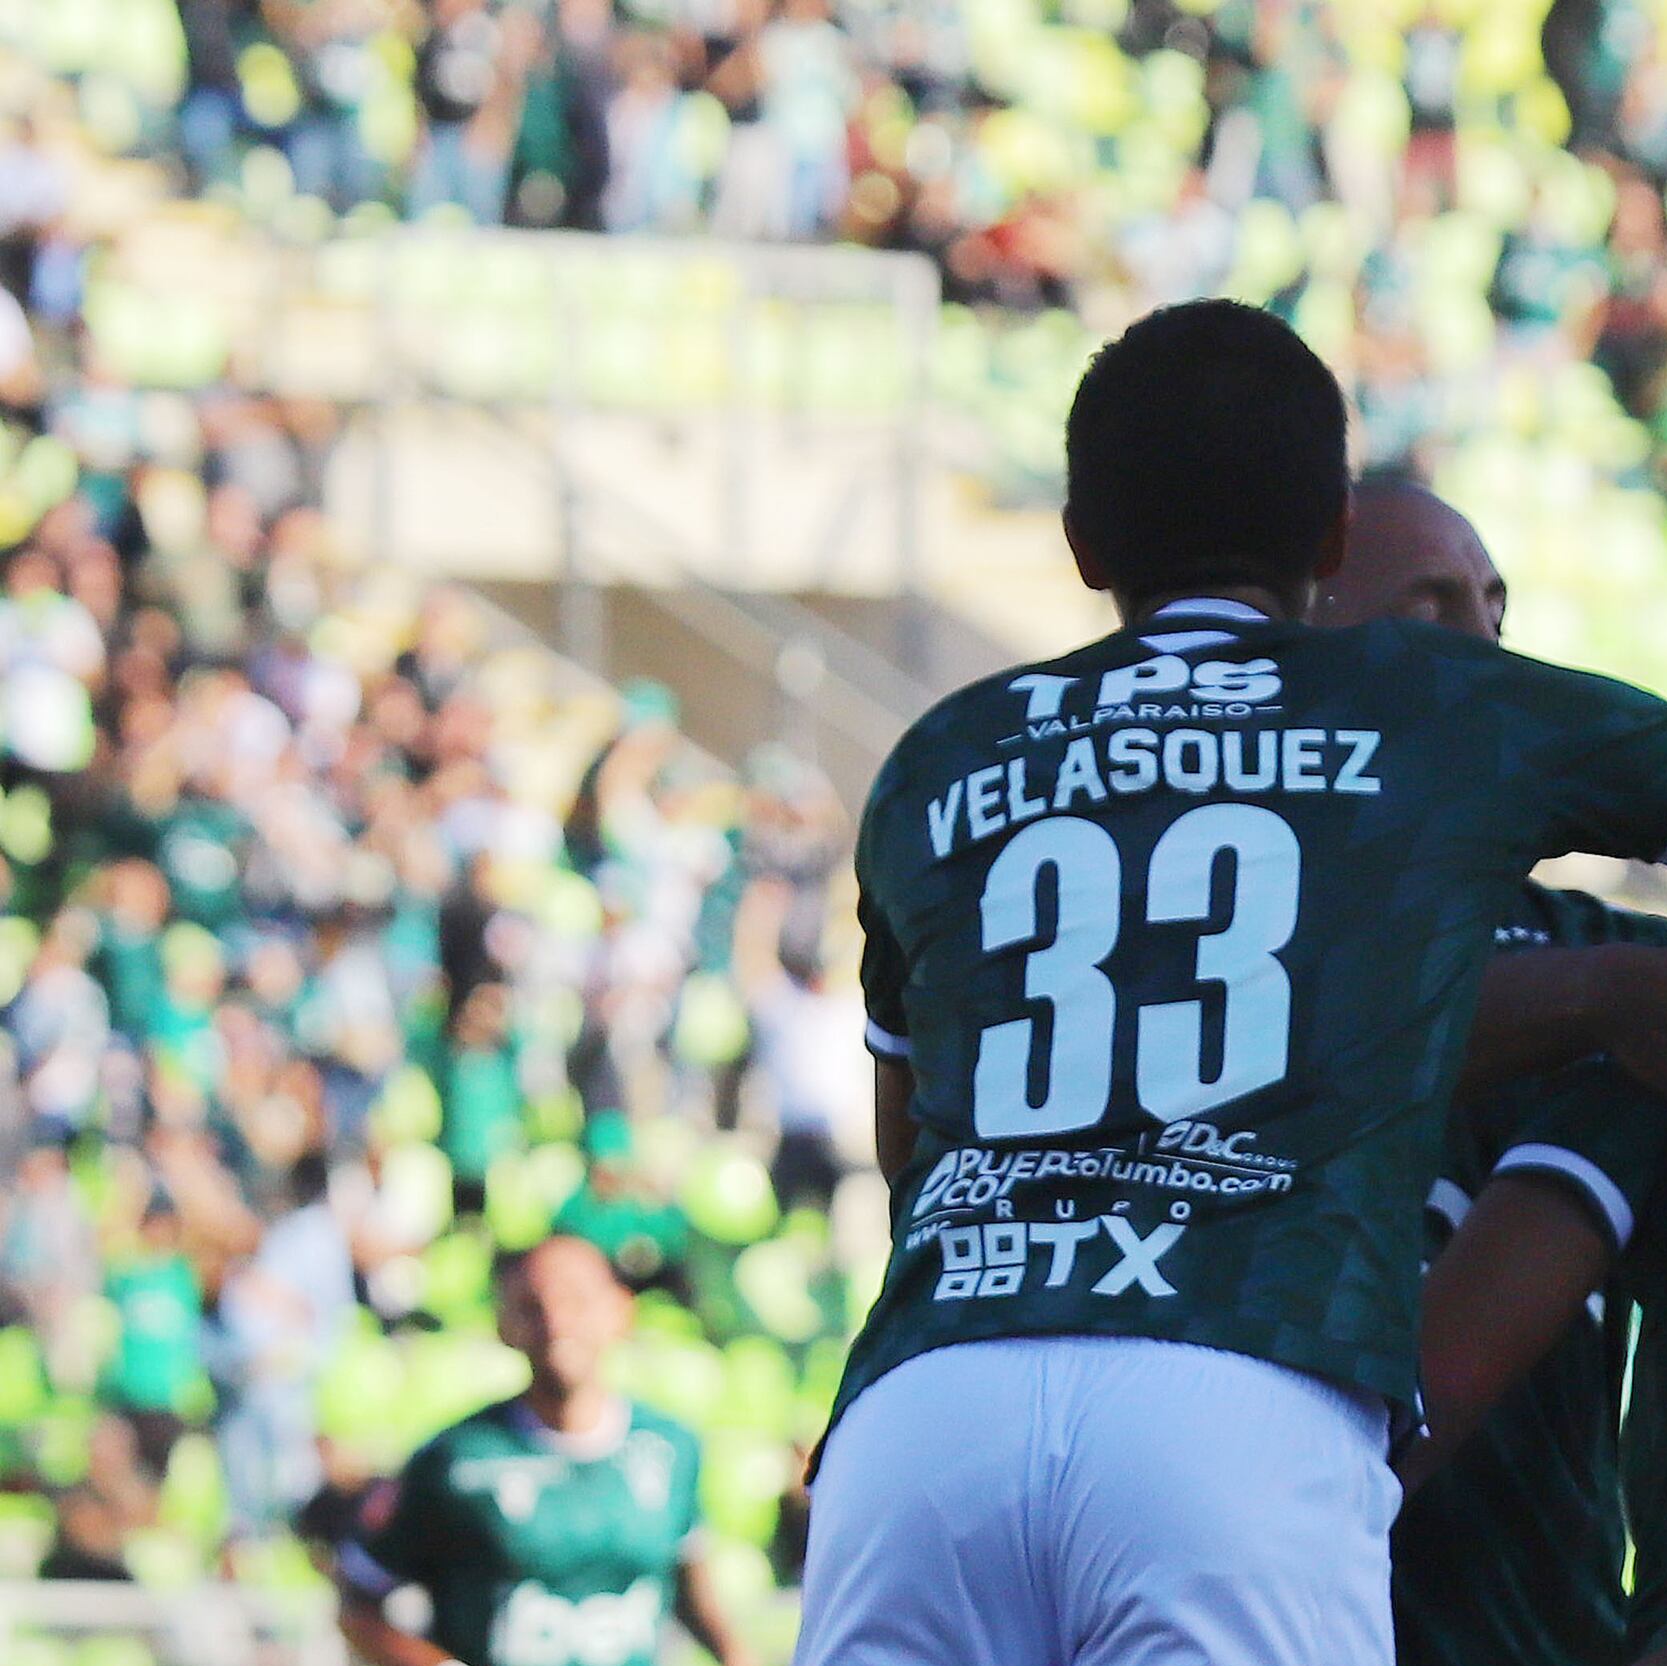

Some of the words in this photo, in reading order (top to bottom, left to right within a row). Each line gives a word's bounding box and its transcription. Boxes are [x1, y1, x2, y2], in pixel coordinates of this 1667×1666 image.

[1007, 653, 1283, 722] TPS
[1026, 702, 1252, 740] VALPARAISO
[926, 727, 1382, 859] VELASQUEZ
[973, 802, 1301, 1141] 33
